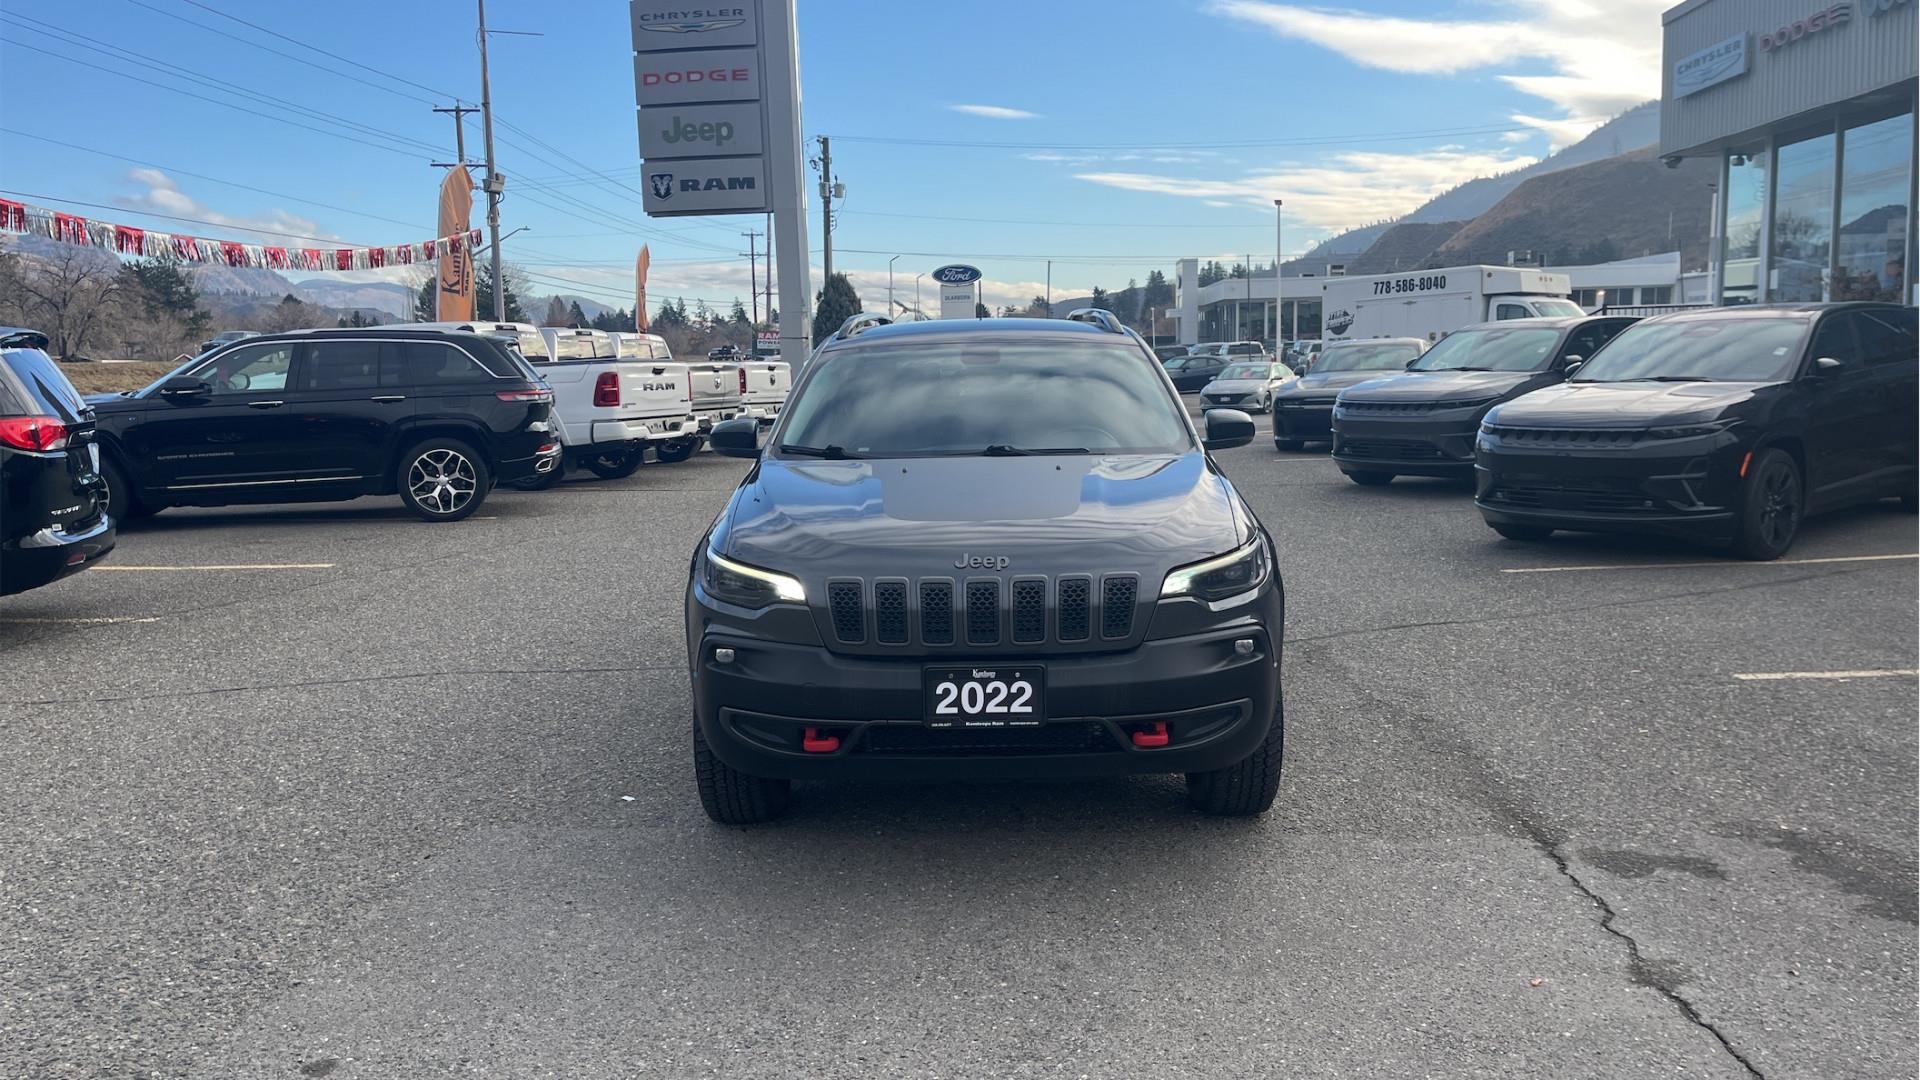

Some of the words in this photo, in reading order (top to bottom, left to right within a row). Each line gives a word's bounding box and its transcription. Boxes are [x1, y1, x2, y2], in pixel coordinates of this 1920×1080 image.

[640, 8, 744, 21] CHRYSLER
[1759, 2, 1852, 53] DODGE
[1677, 39, 1741, 75] CHRYSLER
[643, 68, 749, 86] DODGE
[662, 116, 734, 146] Jeep
[680, 176, 756, 192] RAM
[942, 268, 972, 281] Ford
[1373, 275, 1446, 295] 778-586-8040
[643, 383, 675, 391] RAM
[954, 552, 1010, 571] Jeep
[935, 681, 1033, 714] 2022
